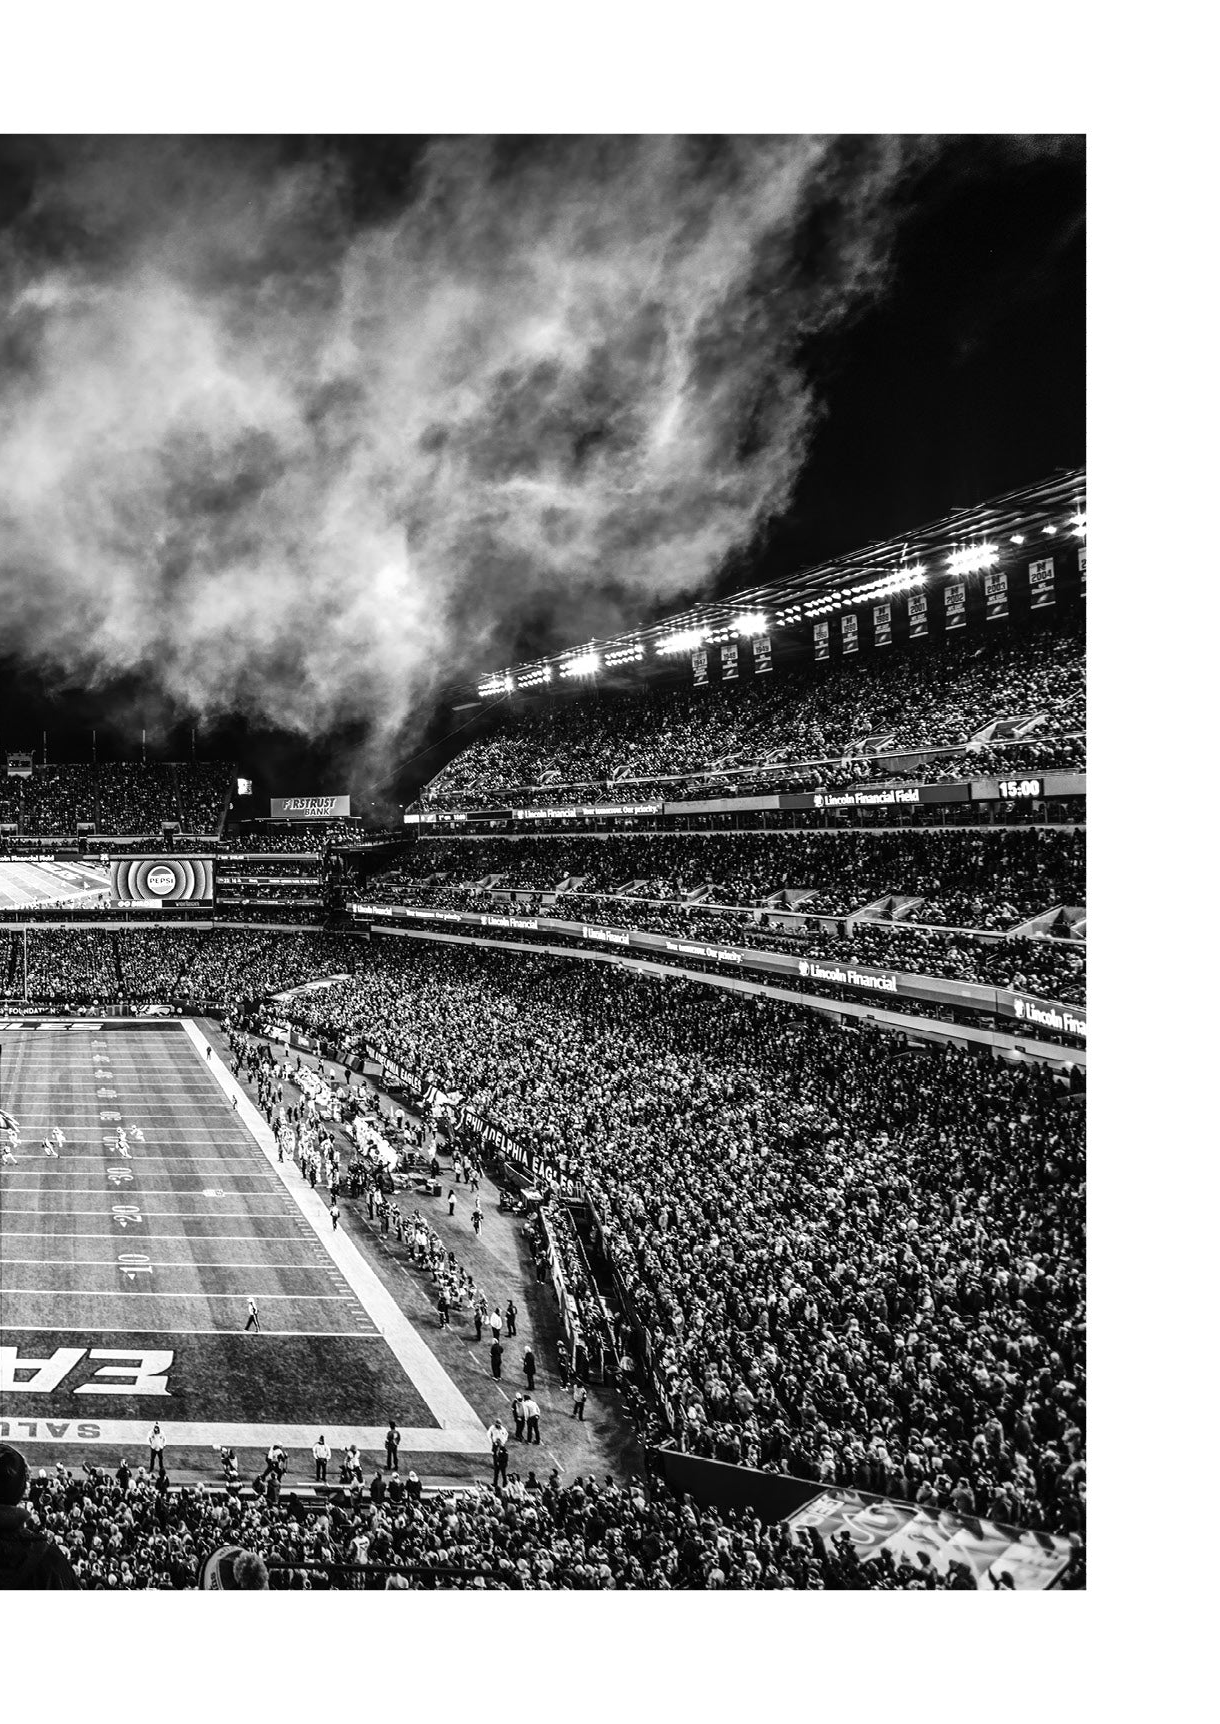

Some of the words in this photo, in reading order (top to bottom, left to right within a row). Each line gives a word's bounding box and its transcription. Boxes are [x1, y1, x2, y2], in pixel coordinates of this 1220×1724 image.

[1030, 568, 1052, 583] 2004
[986, 581, 1006, 594] 2003
[946, 592, 964, 604] 2002
[910, 602, 926, 614] 2001
[999, 779, 1040, 797] 15:00
[282, 797, 337, 810] FIRSTRUST
[825, 793, 855, 806] Lincoln
[855, 790, 895, 804] Financial
[896, 788, 920, 802] Field
[304, 807, 331, 816] BANK
[525, 810, 547, 819] Lincoln
[547, 808, 576, 818] Financial
[149, 877, 174, 885] PEPSI
[488, 916, 509, 927] Lincoln
[509, 917, 538, 930] Financial
[810, 963, 846, 983] Lincoln
[846, 970, 897, 992] Financial
[1025, 1001, 1063, 1028] Lincoln
[107, 1167, 134, 1181] 30
[112, 1205, 143, 1223] 20
[118, 1253, 154, 1274] 10
